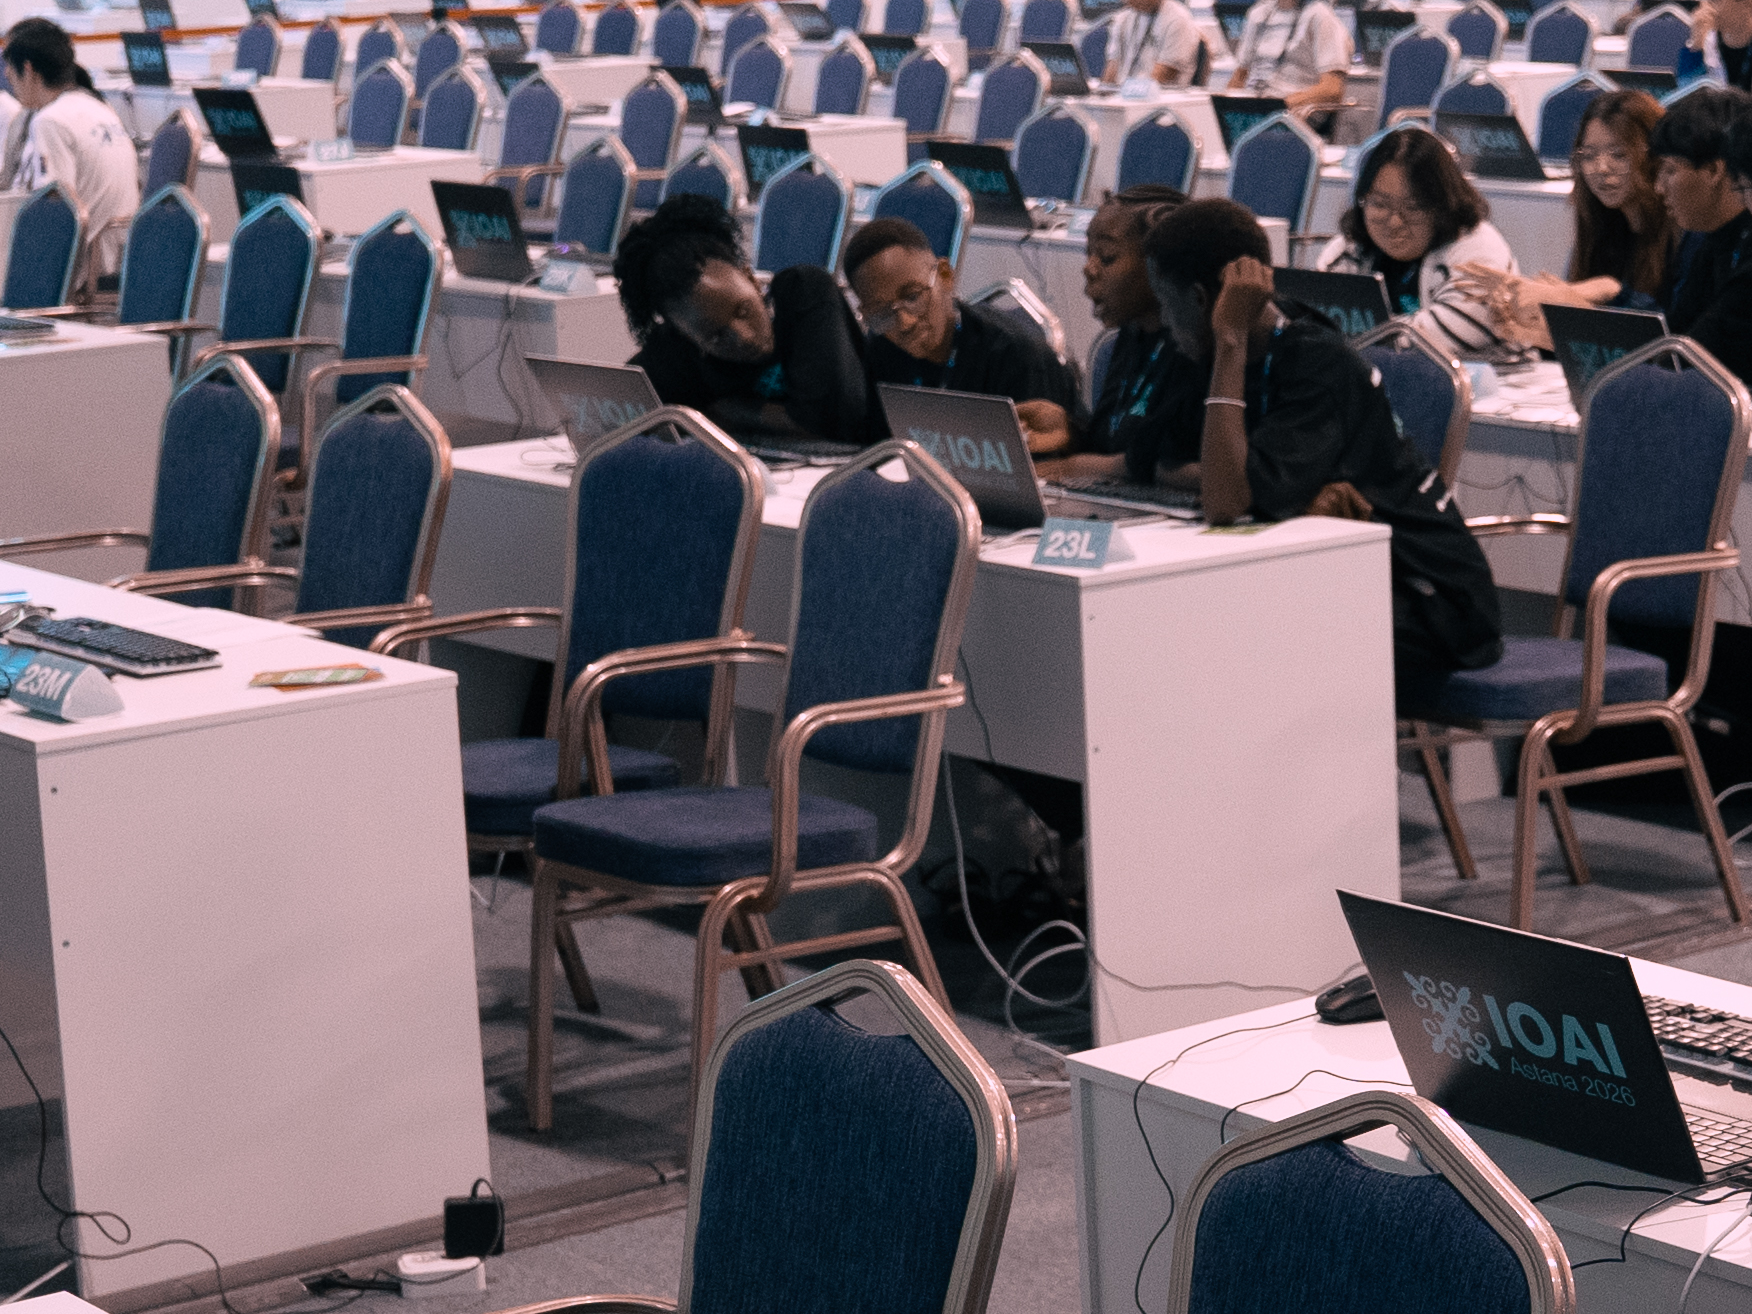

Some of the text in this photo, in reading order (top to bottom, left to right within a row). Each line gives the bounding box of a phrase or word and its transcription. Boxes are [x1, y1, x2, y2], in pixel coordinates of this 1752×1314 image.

[949, 435, 1014, 475] IOAI
[1043, 529, 1095, 559] 23L
[16, 663, 65, 702] 23M
[1483, 994, 1627, 1079] IOAI
[1510, 1056, 1636, 1108] Astana 2026
